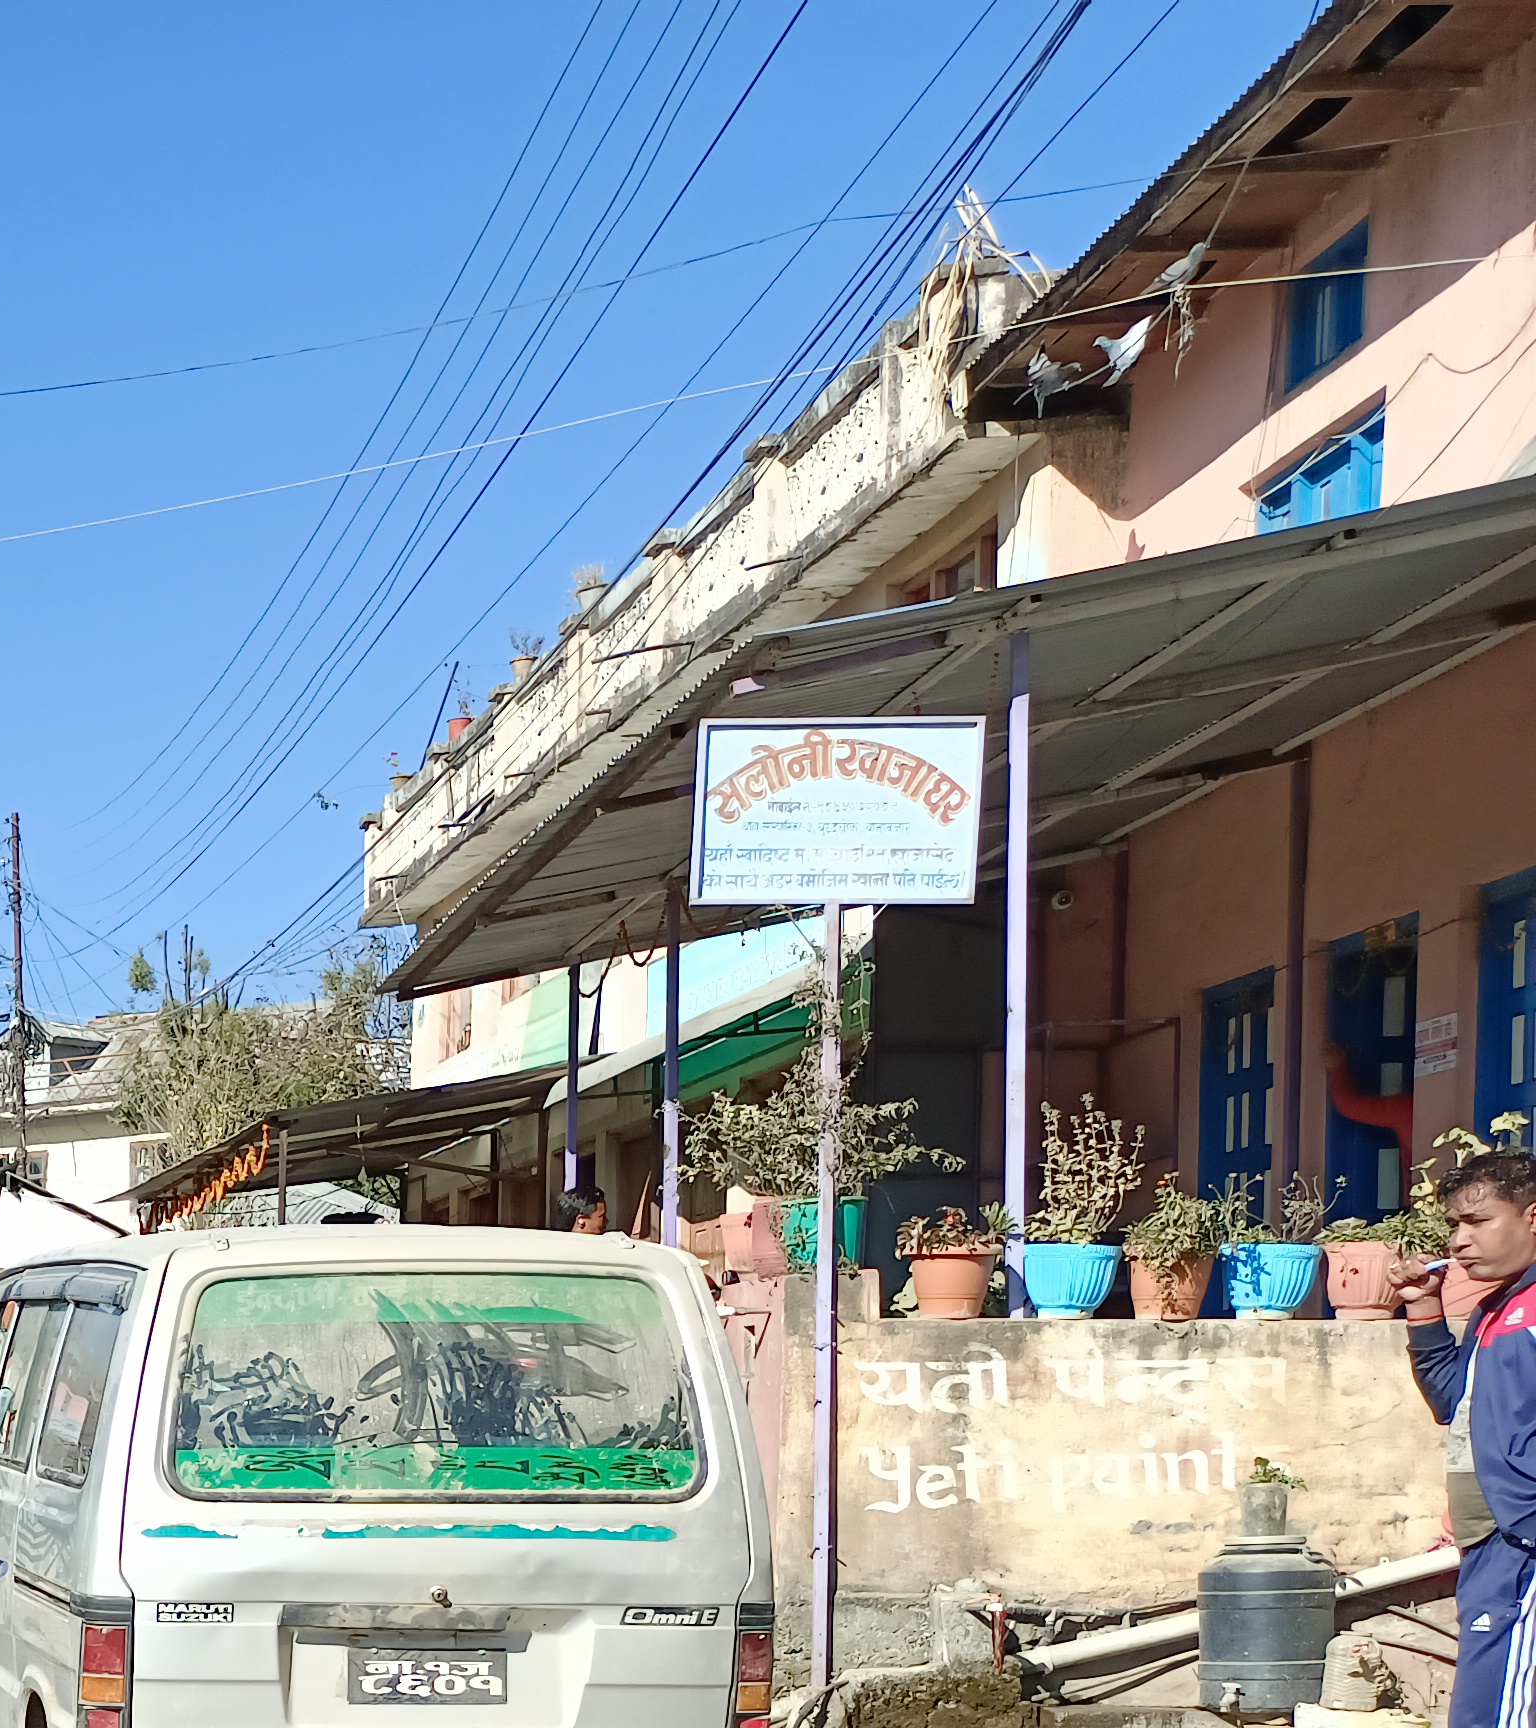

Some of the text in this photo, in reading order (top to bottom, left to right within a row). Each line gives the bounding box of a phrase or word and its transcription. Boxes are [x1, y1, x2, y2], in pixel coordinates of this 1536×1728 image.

[158, 1603, 233, 1613] MARUTI
[158, 1613, 233, 1623] SUZUKI
[623, 1607, 719, 1625] Omni E
